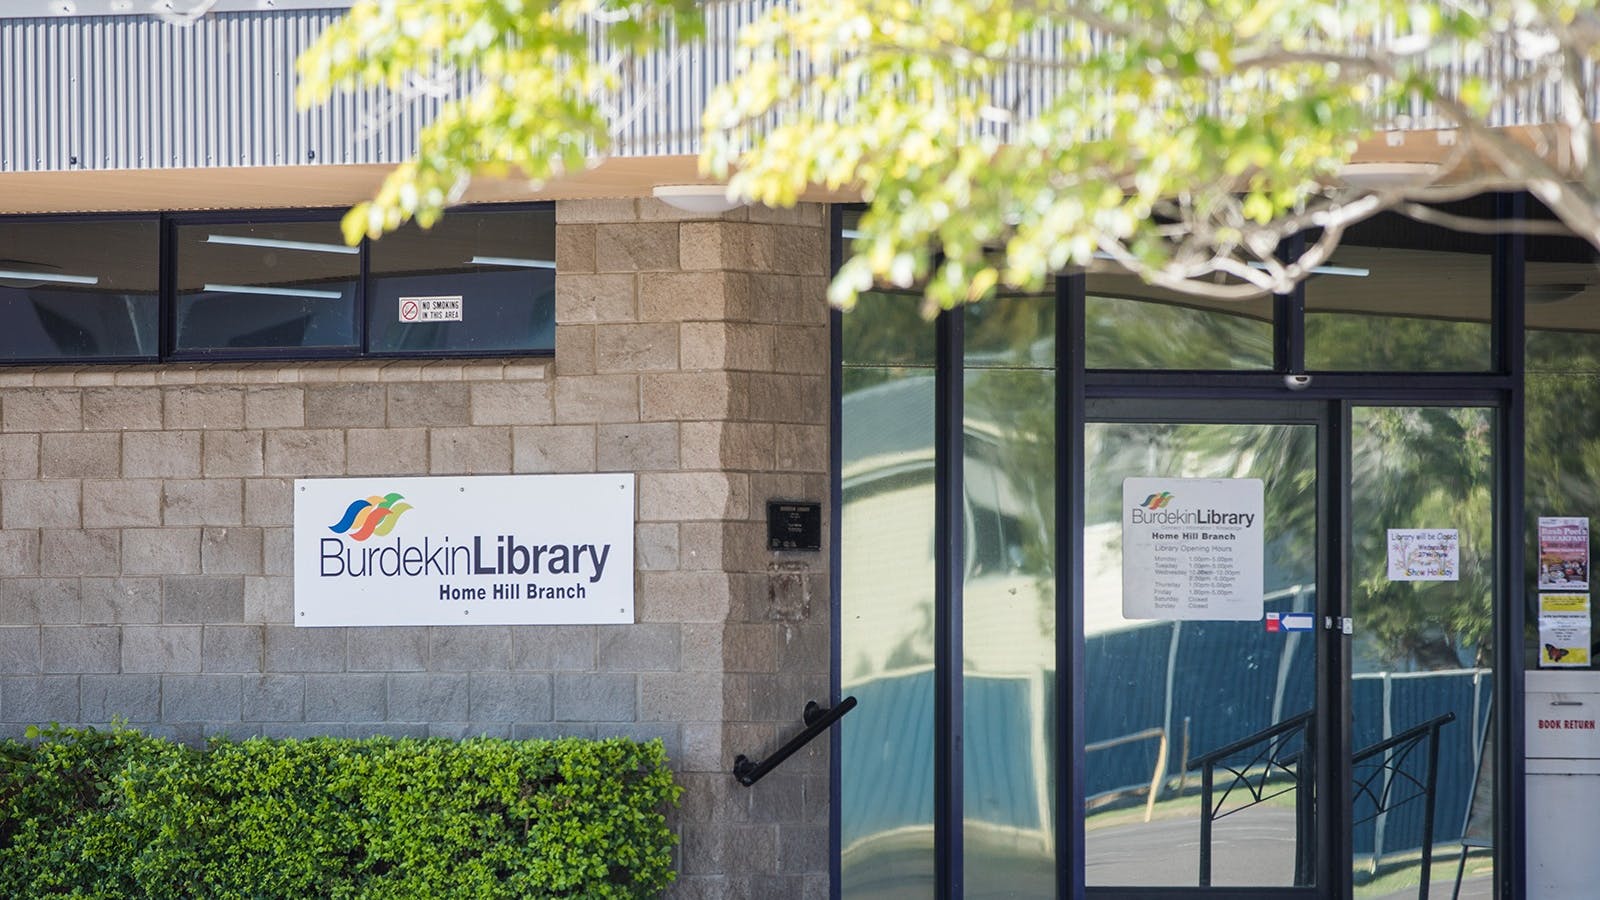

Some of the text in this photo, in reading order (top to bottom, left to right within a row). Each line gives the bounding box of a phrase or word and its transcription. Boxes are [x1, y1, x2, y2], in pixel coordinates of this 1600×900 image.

[422, 301, 459, 310] NO SMOKING
[422, 311, 459, 319] IN THIS AREA
[1152, 532, 1236, 541] Home Hill Branch
[1154, 545, 1178, 553] Library
[1180, 545, 1210, 553] Opening
[319, 535, 611, 583] BurdekinLibrary
[439, 583, 586, 600] Home Hill Branch
[1538, 719, 1596, 729] BOOK RETURN
